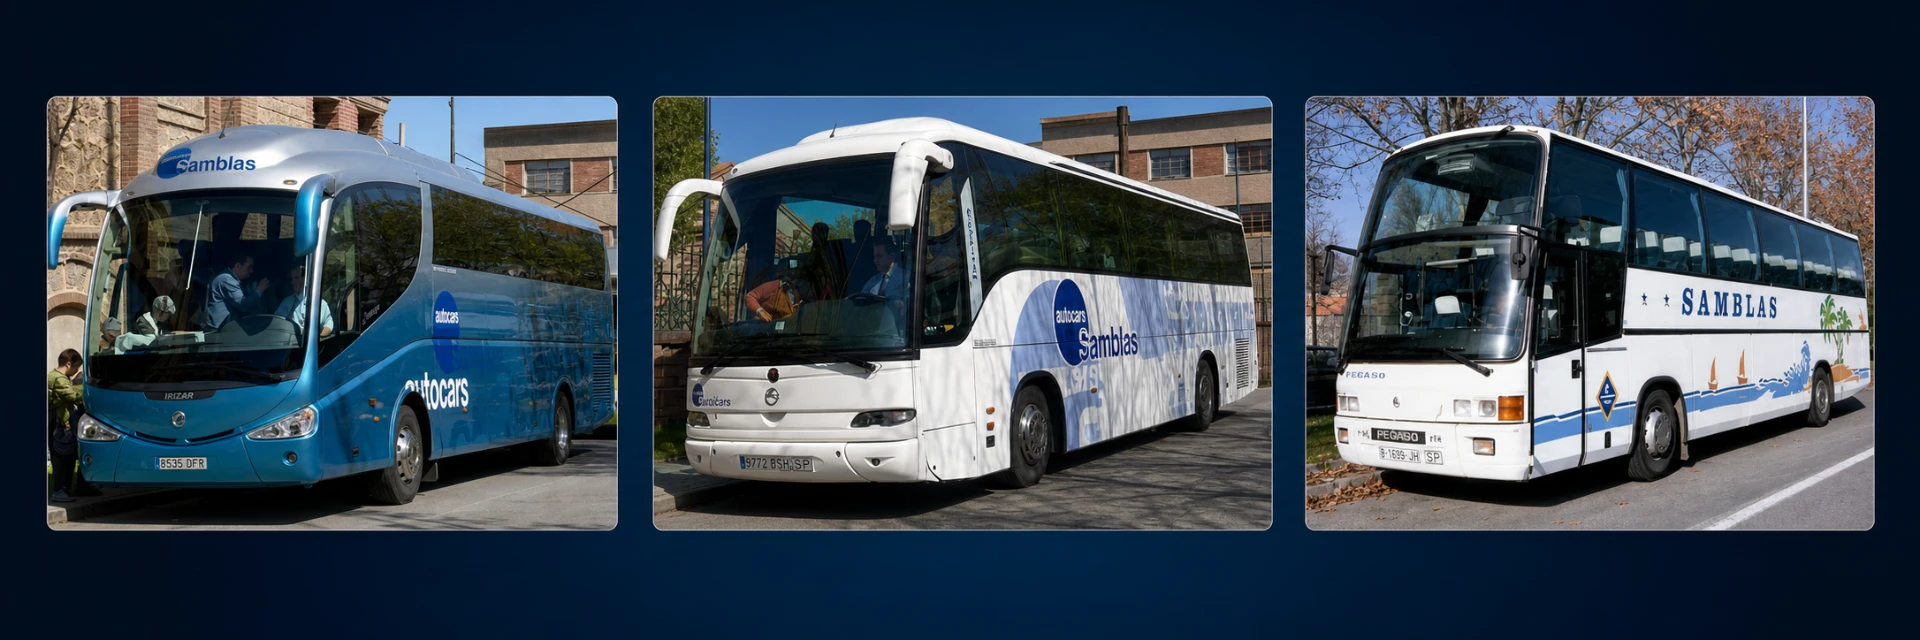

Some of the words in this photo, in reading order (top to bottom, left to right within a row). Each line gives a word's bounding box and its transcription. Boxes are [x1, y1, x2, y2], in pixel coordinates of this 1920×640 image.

[176, 156, 256, 174] Samblas
[1681, 287, 1777, 319] SAMBLAS
[435, 308, 459, 324] autocars
[1056, 307, 1087, 324] autocars
[1079, 326, 1138, 361] Samblas
[1345, 371, 1386, 379] PEGASO
[164, 392, 194, 400] IRIZAR
[1376, 429, 1419, 442] PEGASO
[160, 458, 183, 469] 8535
[186, 458, 205, 469] DFR
[745, 457, 768, 469] 9772
[770, 458, 790, 470] BSH
[794, 459, 810, 470] SP
[1426, 452, 1440, 463] SP
